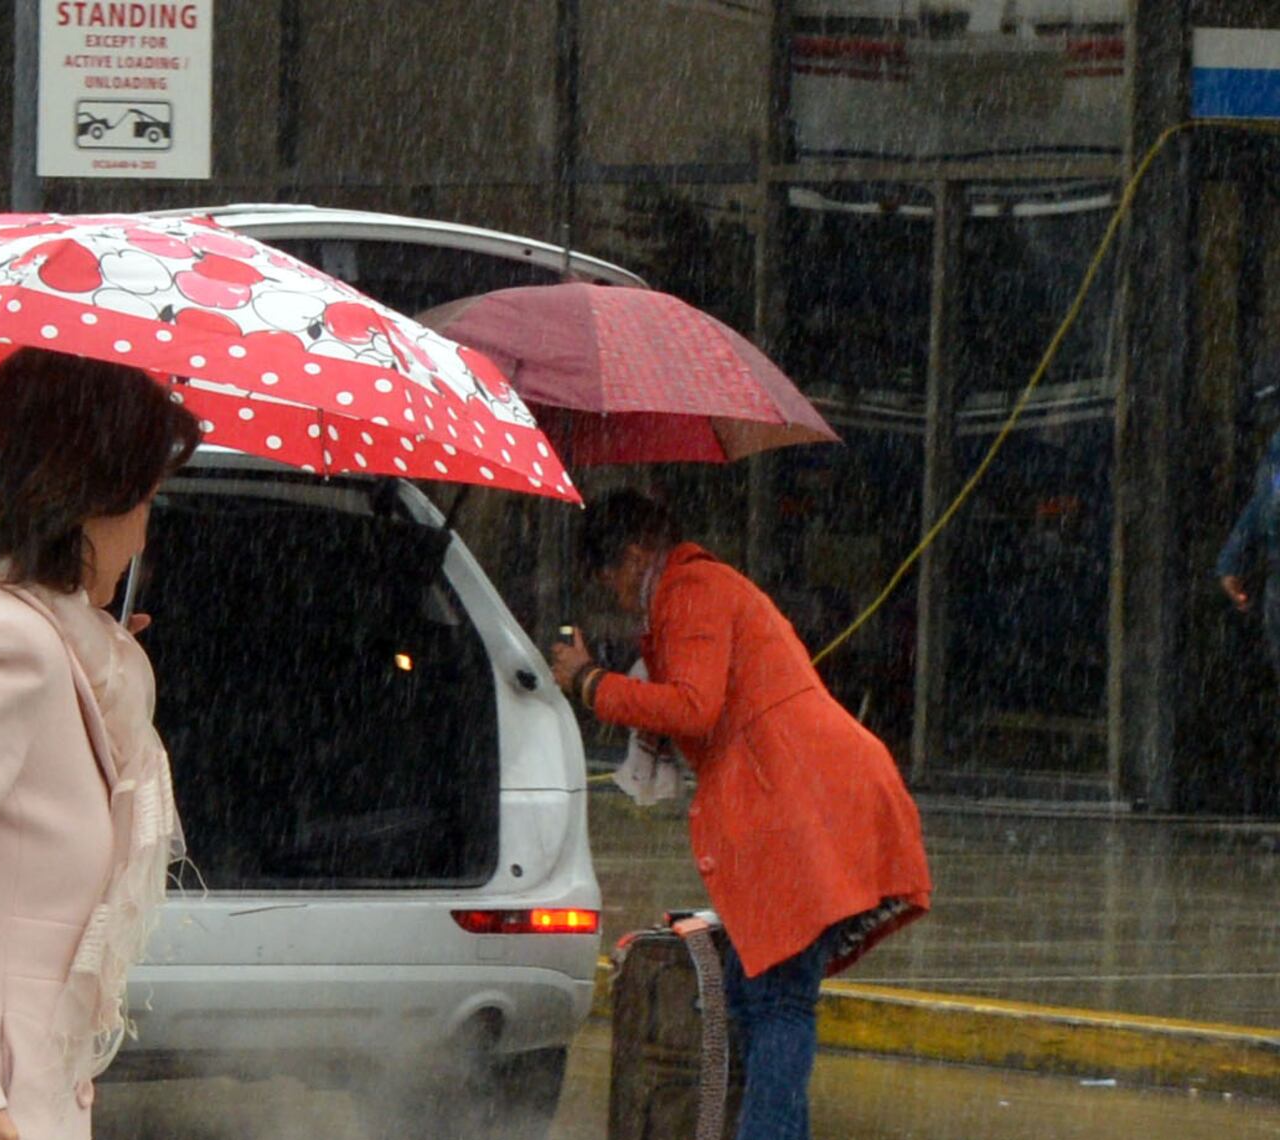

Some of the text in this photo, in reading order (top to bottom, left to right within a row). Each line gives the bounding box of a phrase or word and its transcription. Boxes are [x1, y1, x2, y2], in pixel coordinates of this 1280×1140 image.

[57, 2, 198, 29] STANDING
[85, 34, 168, 49] EXCEPT FOR
[64, 55, 112, 69] ACTIVE
[117, 56, 180, 70] LOADING
[84, 76, 168, 90] UNLOADING
